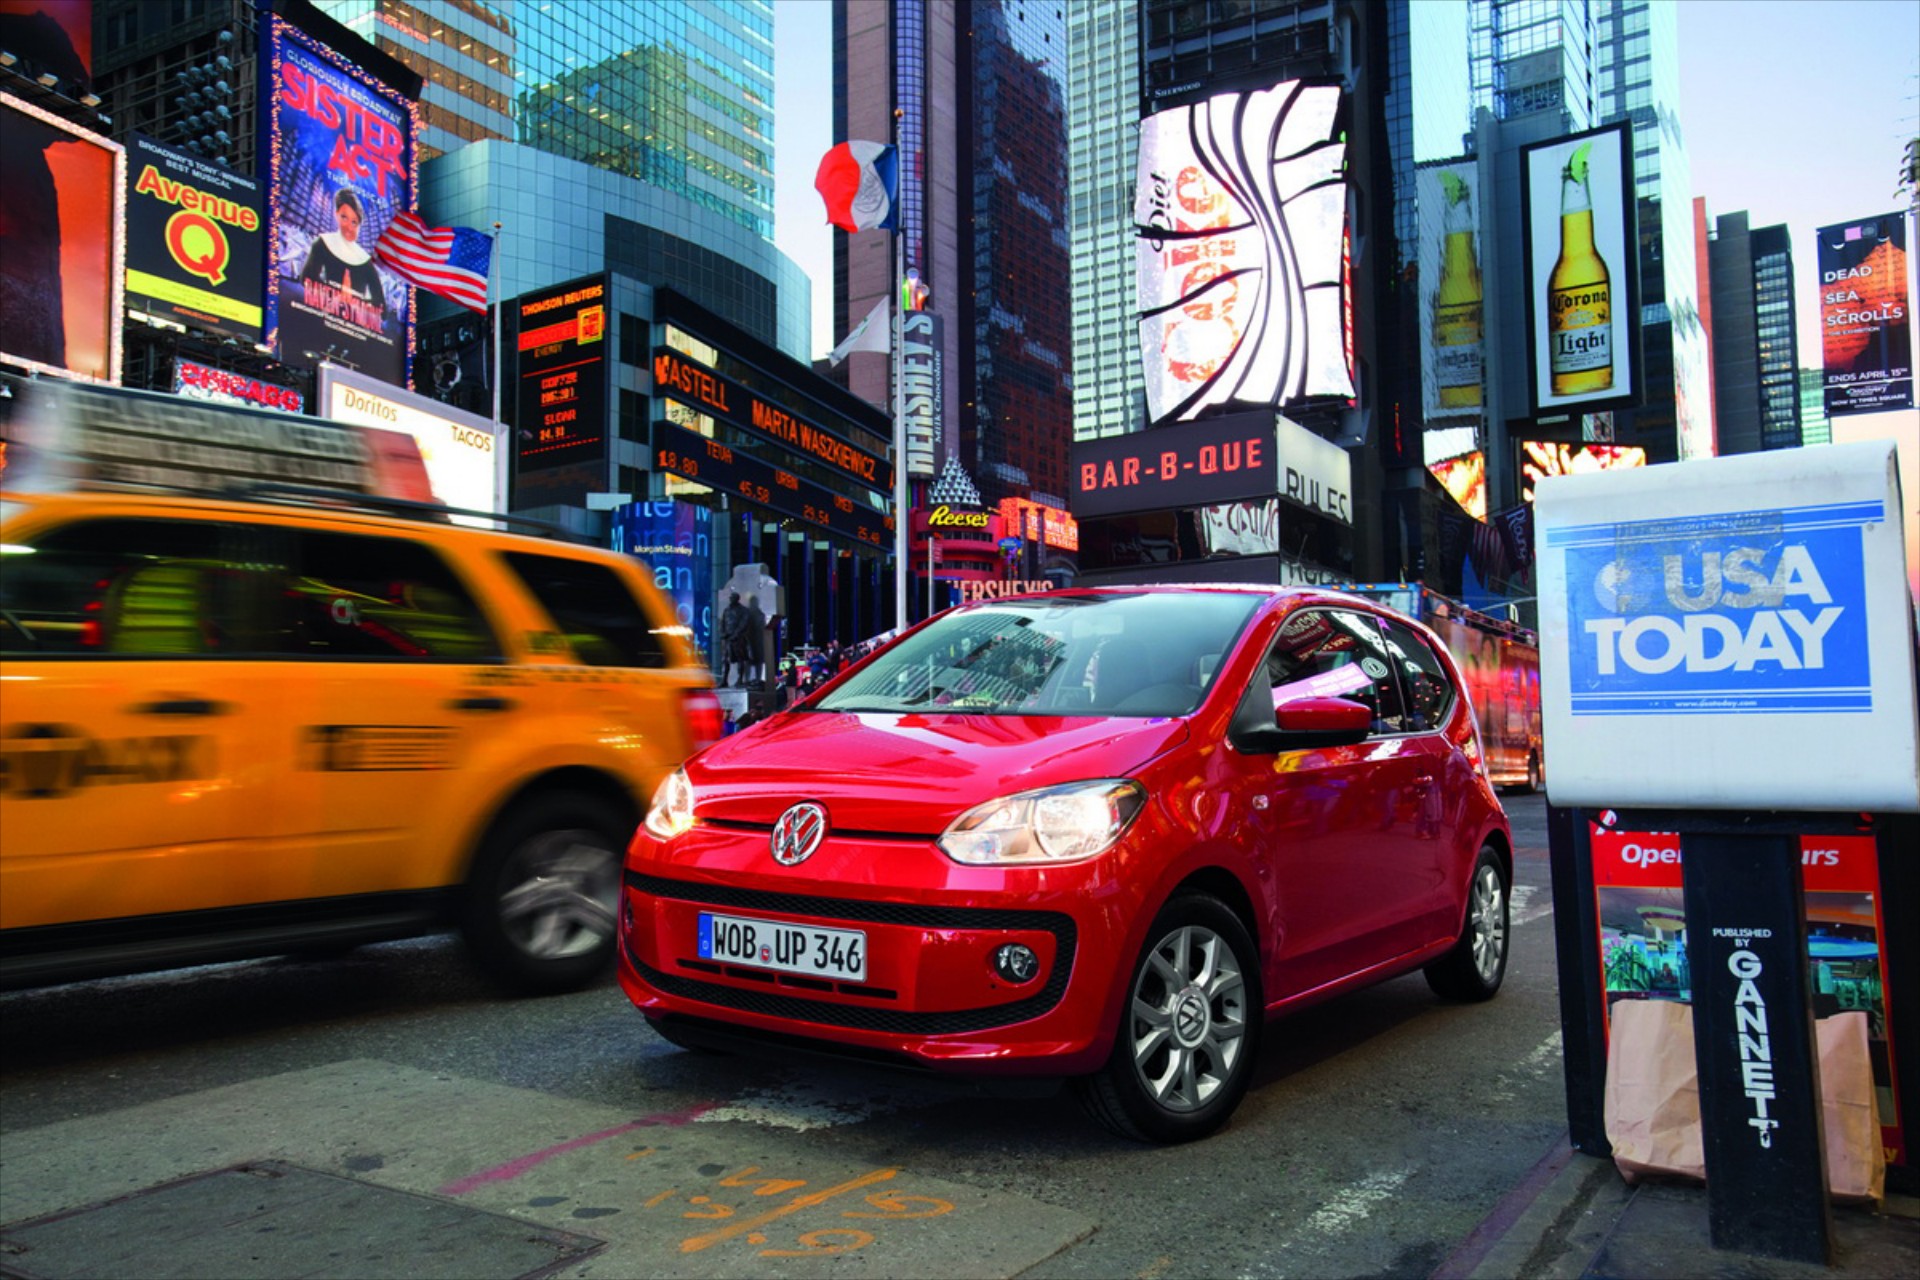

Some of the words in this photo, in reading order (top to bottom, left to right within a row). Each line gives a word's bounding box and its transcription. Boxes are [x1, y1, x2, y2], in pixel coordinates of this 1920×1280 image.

[286, 49, 349, 93] GLORIOUSLY
[351, 87, 401, 124] BROADWAY
[281, 62, 407, 180] SISTER
[139, 140, 194, 167] BROADWAY'S
[328, 133, 395, 198] ACT
[166, 159, 189, 173] BEST
[191, 169, 232, 190] MUSICAL
[135, 165, 259, 231] Avenue
[165, 209, 229, 287] Q
[1824, 265, 1872, 283] DEAD
[521, 295, 562, 317] THOMSON
[564, 285, 604, 306] REUTERS
[1554, 290, 1607, 314] Corona
[1825, 290, 1859, 304] SEA
[1827, 306, 1904, 327] SCROLLS
[1558, 331, 1605, 356] Light
[933, 351, 942, 412] Chocolate
[1828, 374, 1857, 383] ENDS
[1859, 370, 1889, 380] APRIL
[345, 388, 398, 422] Doritos
[752, 399, 799, 445] MARTA
[451, 424, 492, 453] TACOS
[1080, 438, 1262, 491] BAR-B-QUE
[928, 504, 990, 529] Reese's
[634, 545, 663, 555] Morgan
[663, 544, 693, 557] Stanley
[1663, 545, 1833, 612] USA
[1584, 606, 1845, 675] TODAY
[713, 920, 757, 960] WOB
[775, 928, 806, 966] UP
[813, 933, 862, 974] 346
[1712, 927, 1772, 939] PUBLISHED
[1735, 938, 1750, 947] BY
